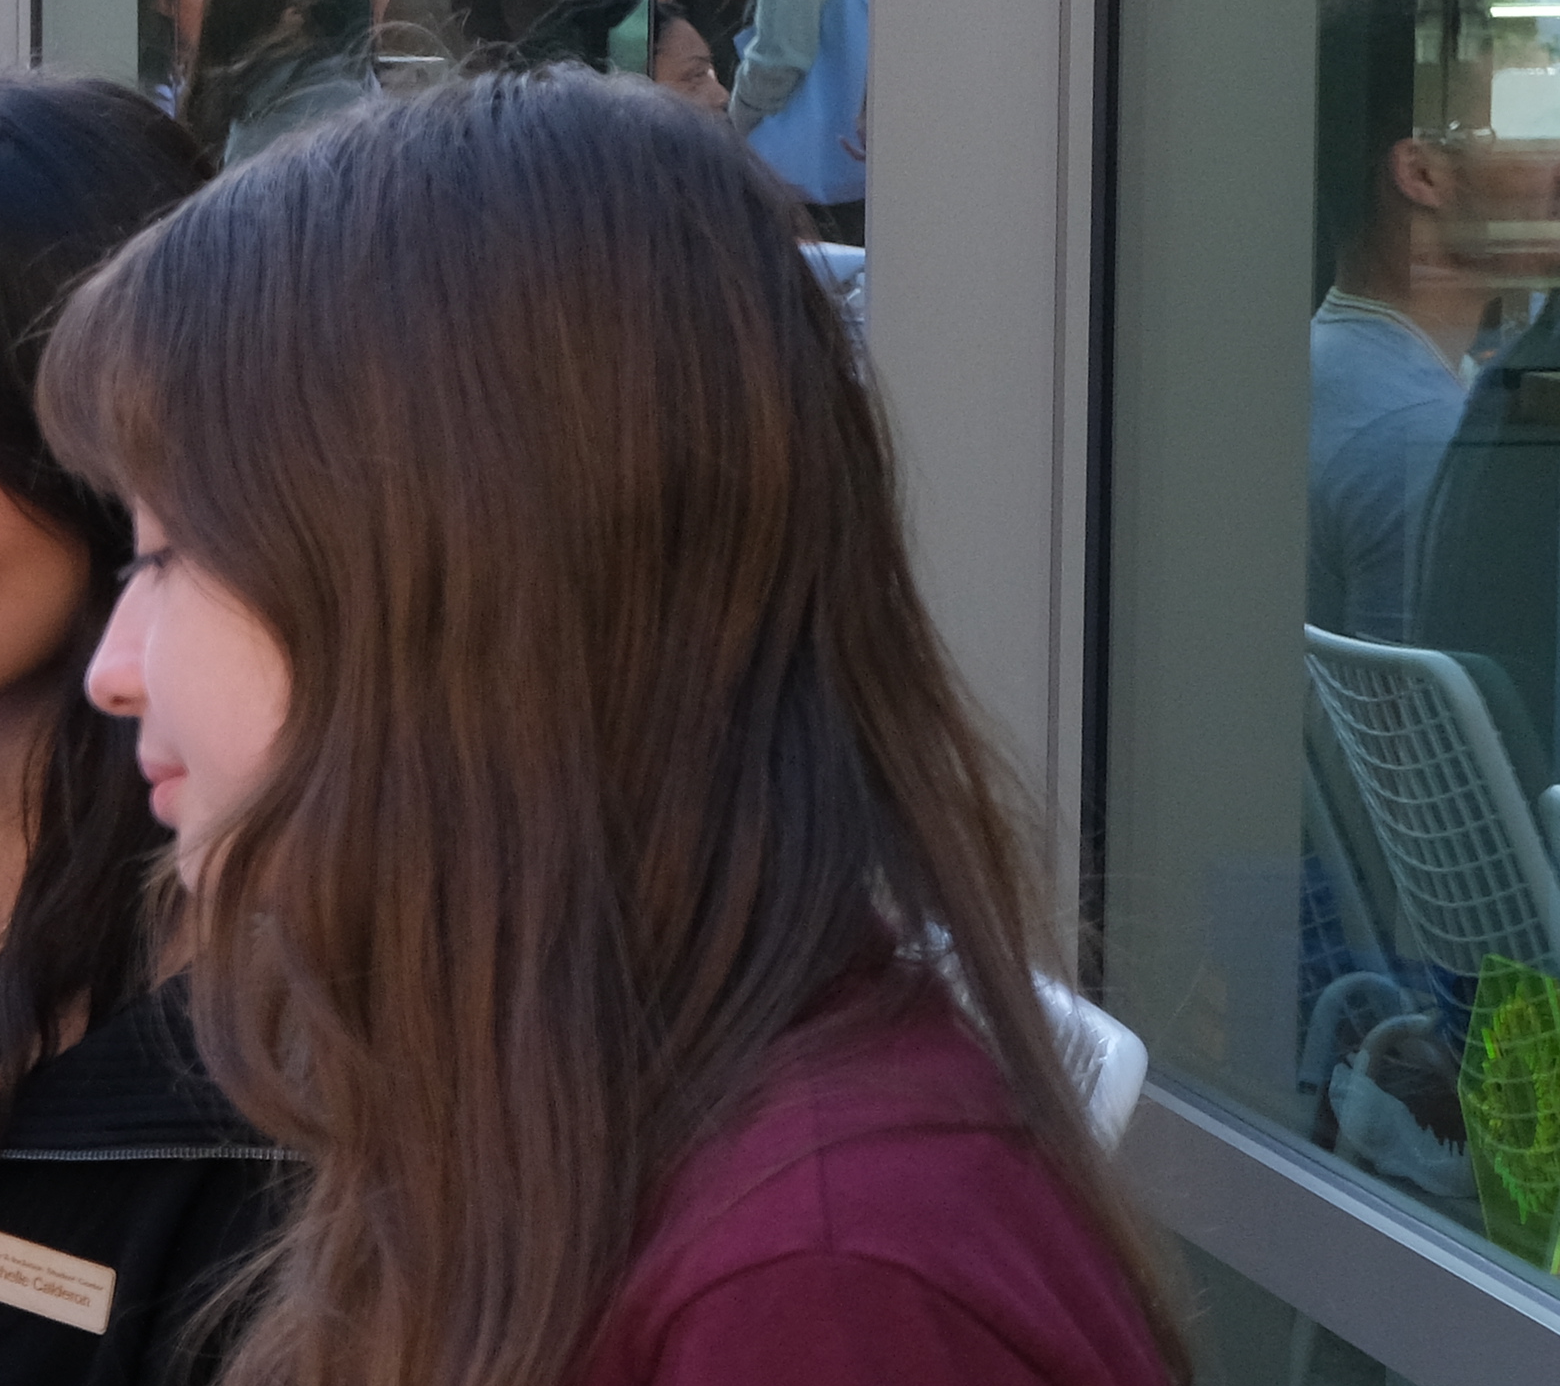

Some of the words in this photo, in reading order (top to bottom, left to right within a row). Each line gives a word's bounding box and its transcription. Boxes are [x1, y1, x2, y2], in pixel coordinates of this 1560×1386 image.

[11, 1255, 43, 1271] Inclusion
[46, 1266, 76, 1281] Student
[78, 1276, 104, 1291] Center
[32, 1276, 91, 1308] Calderon
